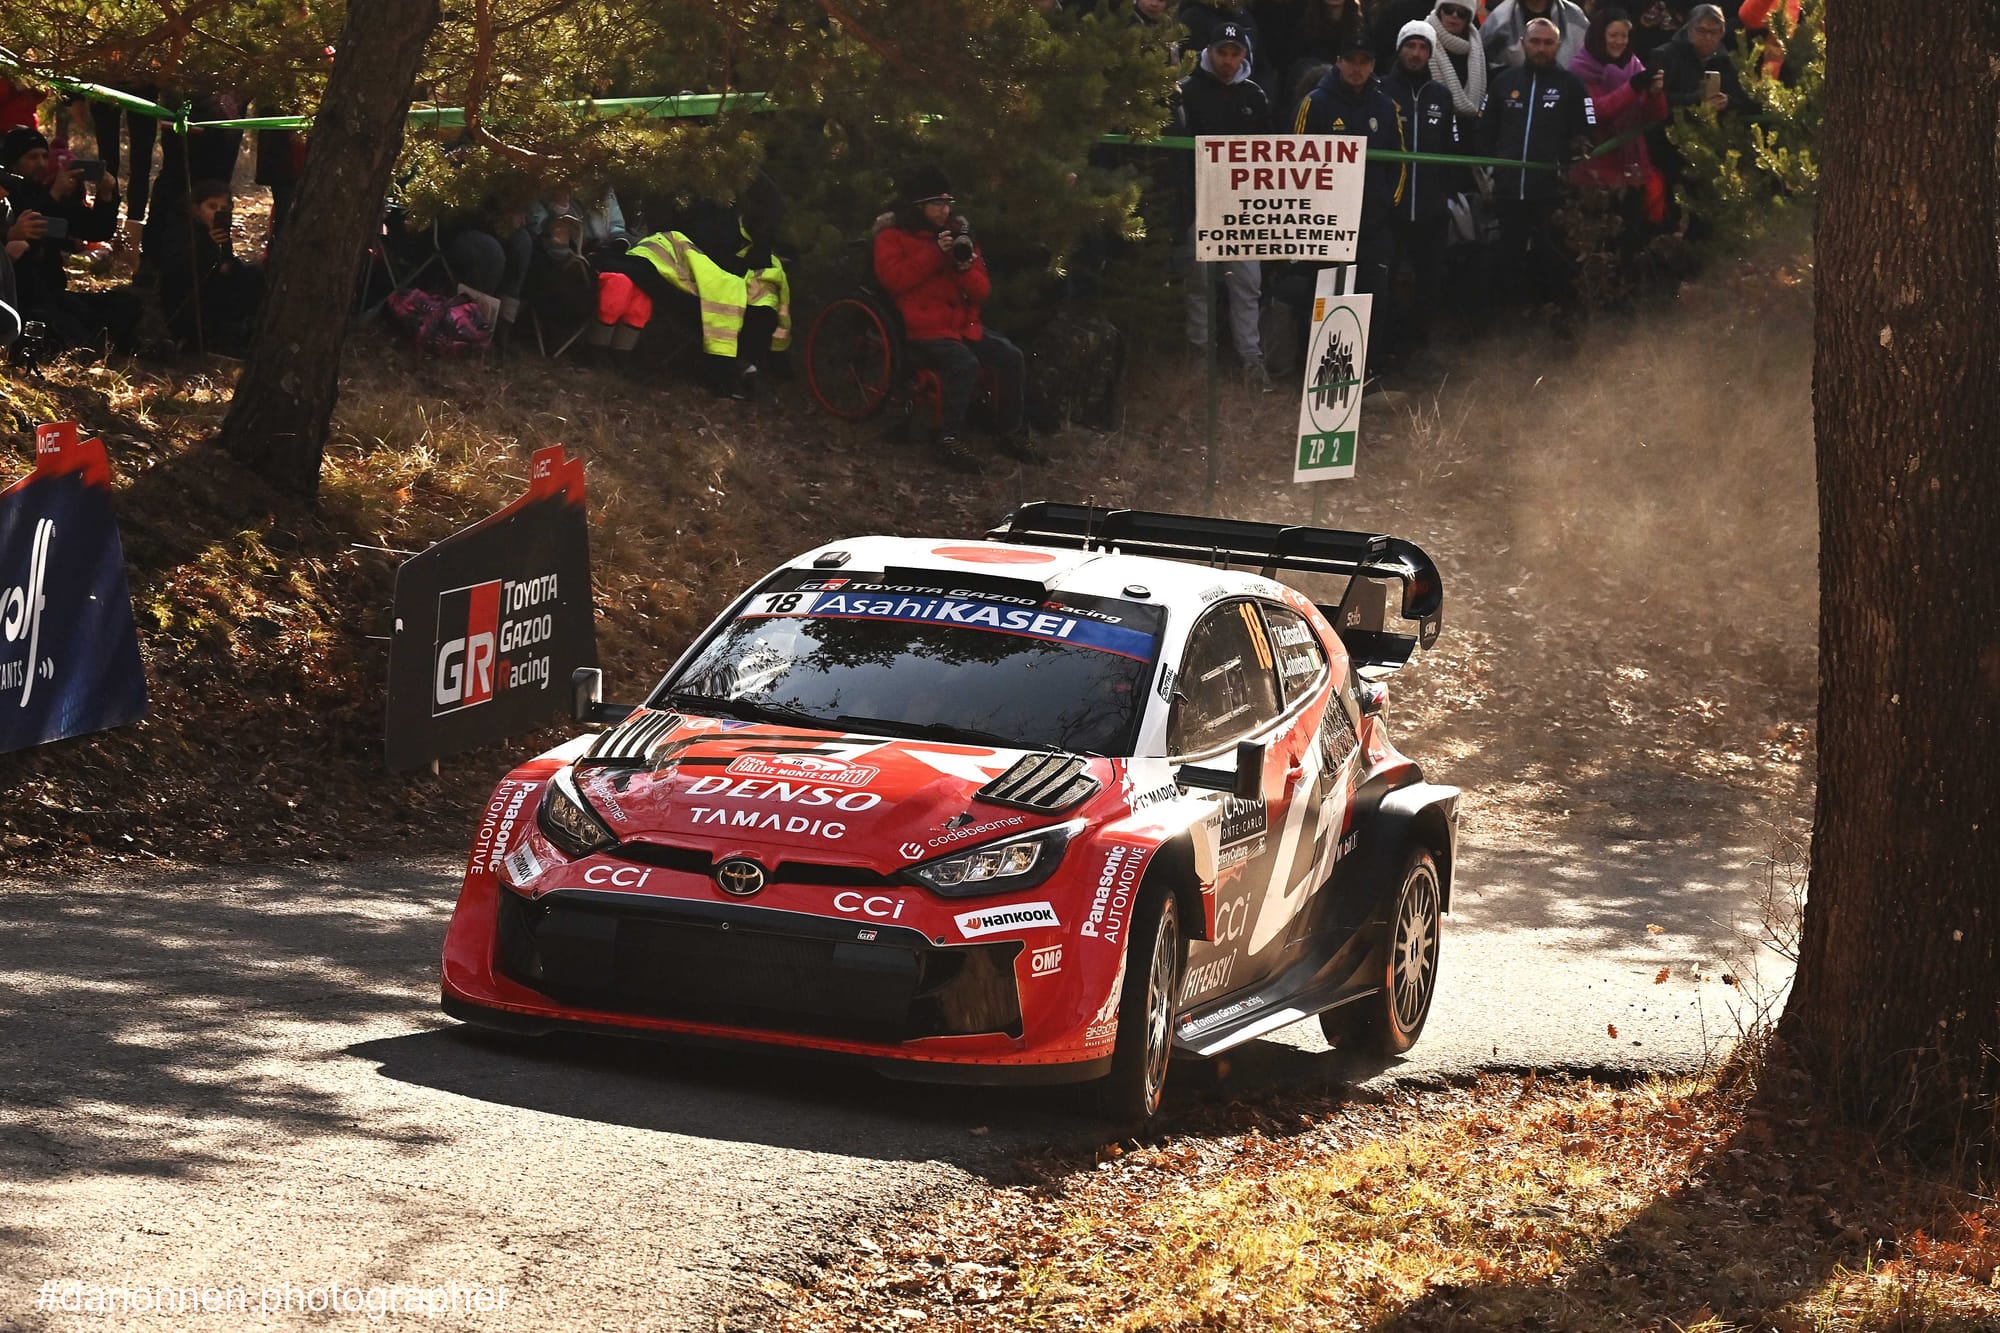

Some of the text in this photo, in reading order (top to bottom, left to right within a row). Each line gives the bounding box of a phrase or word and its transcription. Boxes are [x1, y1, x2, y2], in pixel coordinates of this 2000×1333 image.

[1205, 141, 1357, 163] TERRAIN
[1231, 163, 1333, 190] PRIVÉ
[1223, 212, 1337, 225] DÉCHARGE
[1239, 199, 1311, 210] TOUTE
[1198, 229, 1357, 241] FORMELLEMENT
[1218, 244, 1328, 256] INTERDITE
[1308, 438, 1340, 464] ZP 2
[504, 574, 558, 615] TOYOTA
[766, 593, 800, 613] 18
[849, 583, 944, 595] TOYOTA
[949, 588, 1037, 606] GAZOO
[1042, 600, 1122, 624] Racing
[814, 596, 1078, 638] AsahiKASEI
[500, 614, 552, 653] GAZOO
[1239, 602, 1273, 670] 18
[0, 660, 23, 690] ANTS
[436, 632, 494, 705] GR
[498, 652, 550, 690] Racing
[735, 761, 865, 784] RALLYE MONTE-CARLO
[684, 775, 882, 811] DENSO
[470, 780, 516, 874] AUTOMOTIVE
[489, 782, 538, 872] Panasonic
[690, 807, 846, 839] TAMADIC
[928, 816, 1024, 847] codebeamer
[584, 865, 652, 888] CCi
[1080, 846, 1127, 938] Panasonic
[833, 891, 905, 919] CCi
[1104, 847, 1147, 944] AUTOMOTIVE
[1031, 950, 1063, 972] OMP
